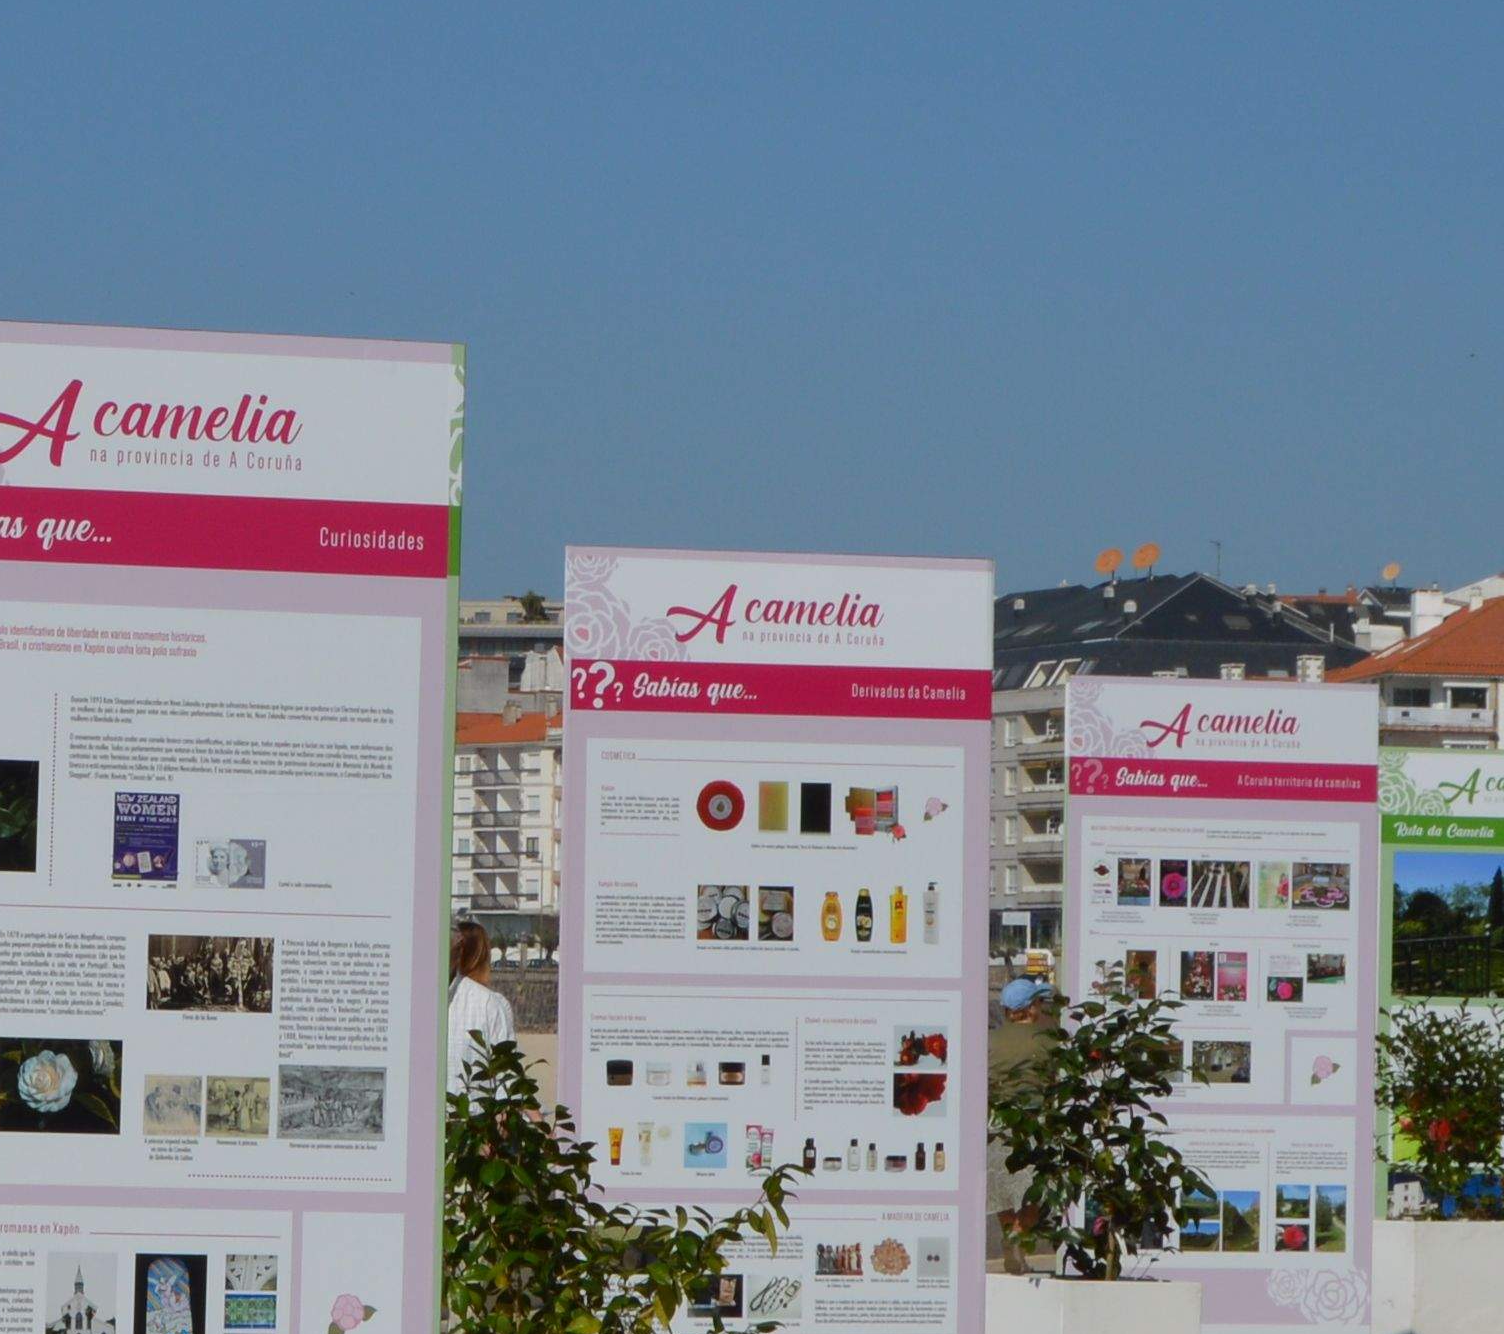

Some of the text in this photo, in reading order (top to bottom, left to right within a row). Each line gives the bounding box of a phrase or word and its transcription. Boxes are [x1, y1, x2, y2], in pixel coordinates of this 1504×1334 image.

[93, 393, 303, 445] camelia
[90, 449, 302, 471] na provincia de A Coruña
[36, 518, 113, 550] que...
[320, 527, 424, 550] Curiosidades
[666, 584, 885, 644] A camelia
[742, 631, 884, 646] na provincia de A Coruña
[633, 672, 759, 705] Sabías que...
[852, 683, 966, 700] Derivados da Camelia
[1139, 703, 1301, 749] A camelia
[1237, 774, 1361, 789] A Coruña territorio de camelias
[1438, 768, 1483, 805] A
[116, 794, 177, 804] NEW ZEALAND
[117, 803, 177, 816] WOMEN
[1397, 821, 1494, 838] Ruta da Camelia
